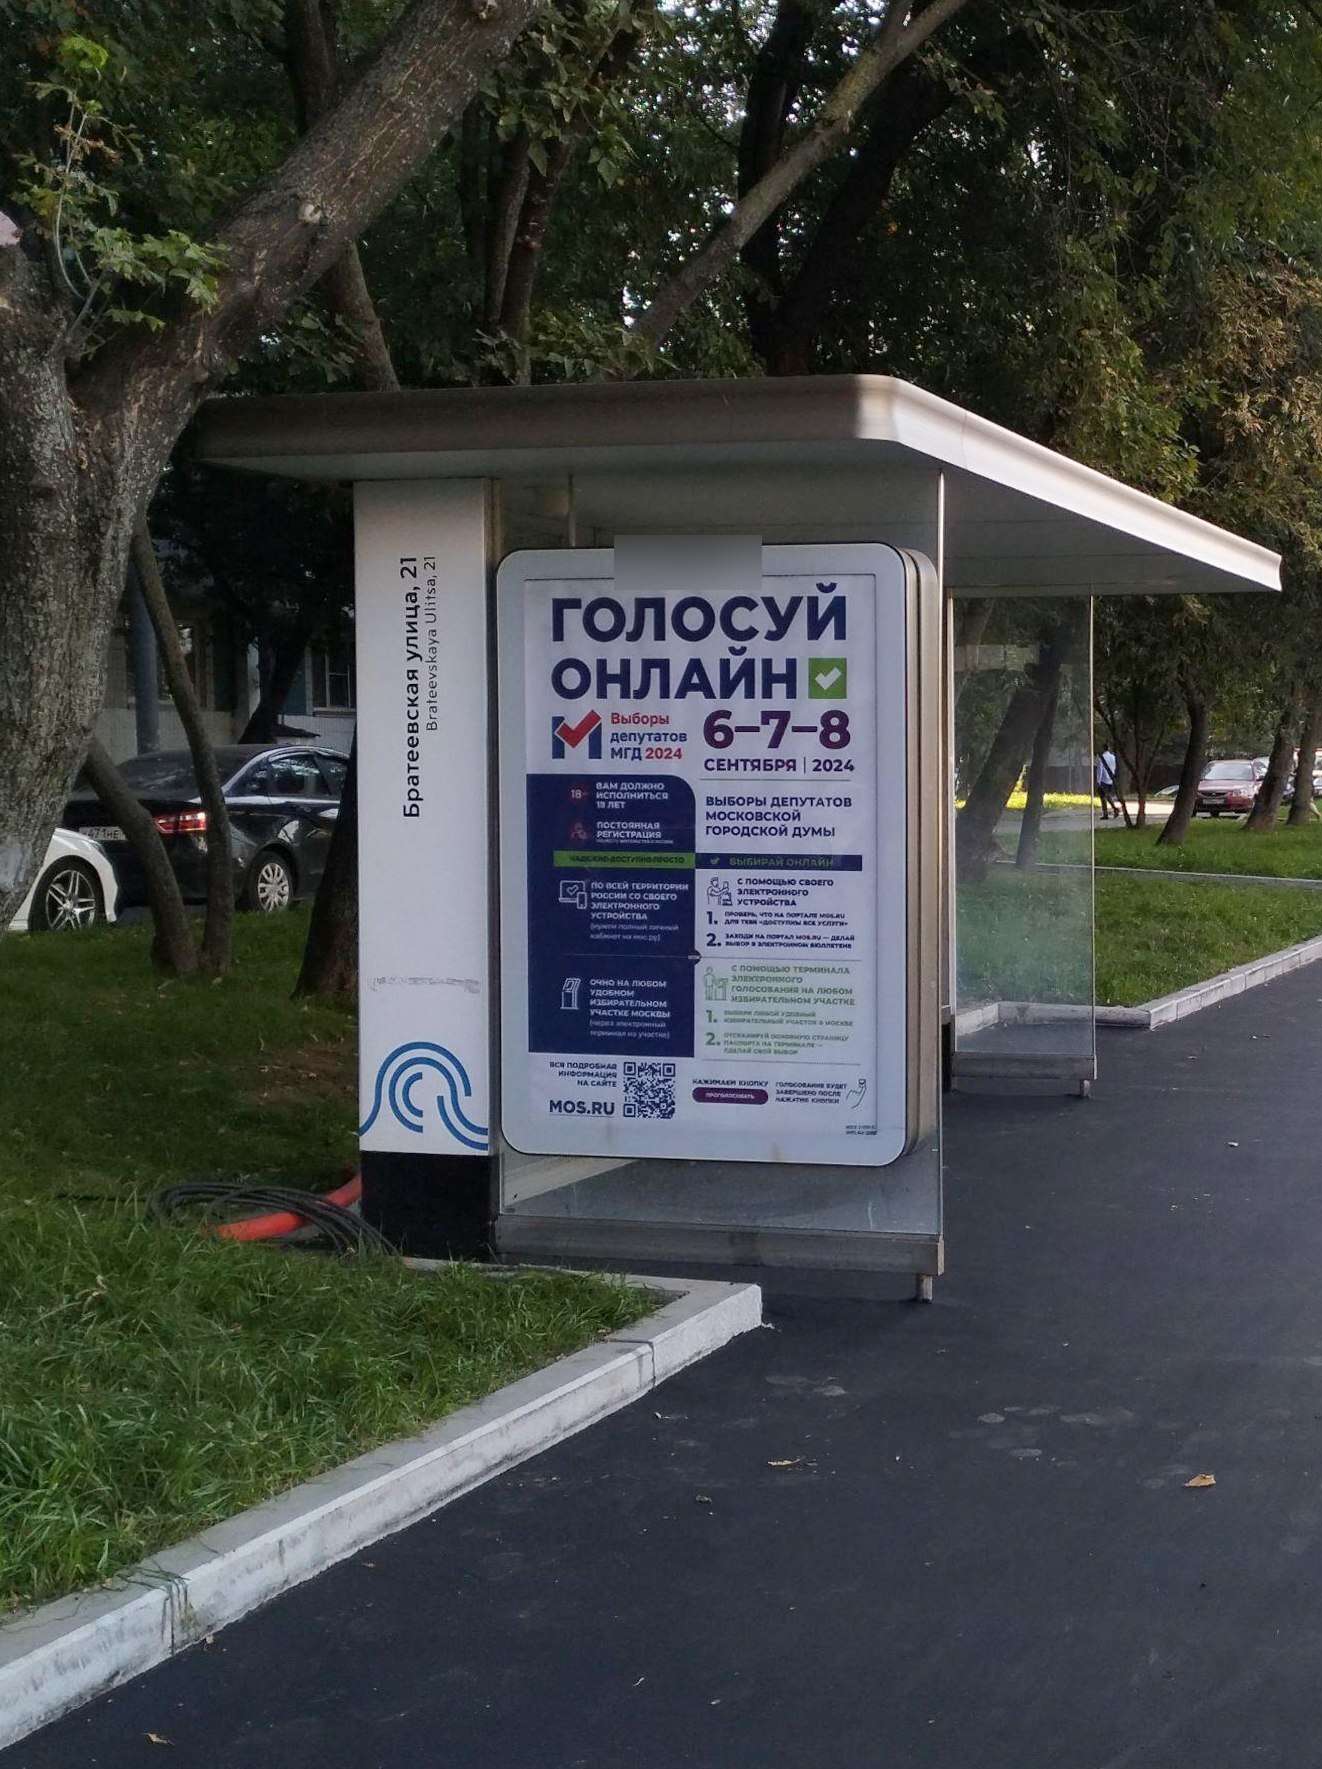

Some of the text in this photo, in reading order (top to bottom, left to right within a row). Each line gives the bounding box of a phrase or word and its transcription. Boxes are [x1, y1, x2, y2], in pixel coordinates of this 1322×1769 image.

[552, 582, 847, 642] ГОЛОСУЙ
[424, 556, 439, 730] Brateevskaya Ulitsa, 21
[551, 646, 797, 700] ОНЛАЙН
[400, 557, 423, 817] Братеевская улица, 21
[611, 712, 669, 726] Выборы
[610, 731, 687, 743] депутатов
[611, 748, 682, 761] МГД 2024
[704, 758, 855, 772] СЕНТЯБРЯ 2024
[596, 782, 617, 790] ВАМ
[706, 796, 852, 808] ВЫБОРЫ ДЕПУТАТОВ
[706, 809, 801, 821] МОСКОВСКОЙ
[597, 831, 661, 839] РЕГИСТРАЦИЯ
[706, 824, 835, 838] ГОРОДСКОЙ ДУМЫ
[729, 857, 833, 867] ВЫБИРАЙ ОНЛАЙН
[606, 881, 629, 890] ВСЕЙ
[746, 879, 796, 887] ПОМОЩЬЮ
[737, 898, 797, 906] УСТРОЙСТВА
[591, 911, 647, 920] УСТРОЙСТВА
[706, 911, 718, 924] 1.
[706, 933, 721, 947] 2.
[740, 965, 790, 974] ПОМОЩЬЮ
[794, 966, 850, 974] ТЕРМИНАЛА
[732, 986, 799, 994] ГОЛОСОВАНИЯ
[817, 987, 853, 995] ЛЮБОМ
[732, 996, 811, 1004] ИЗБИРАТЕЛЬНОМ
[632, 1010, 671, 1018] МОСКВЫ
[705, 1010, 717, 1023] 1.
[705, 1033, 720, 1045] 2.
[567, 1062, 617, 1070] ПОДРОБНАЯ
[550, 1100, 615, 1115] MOS.RU
